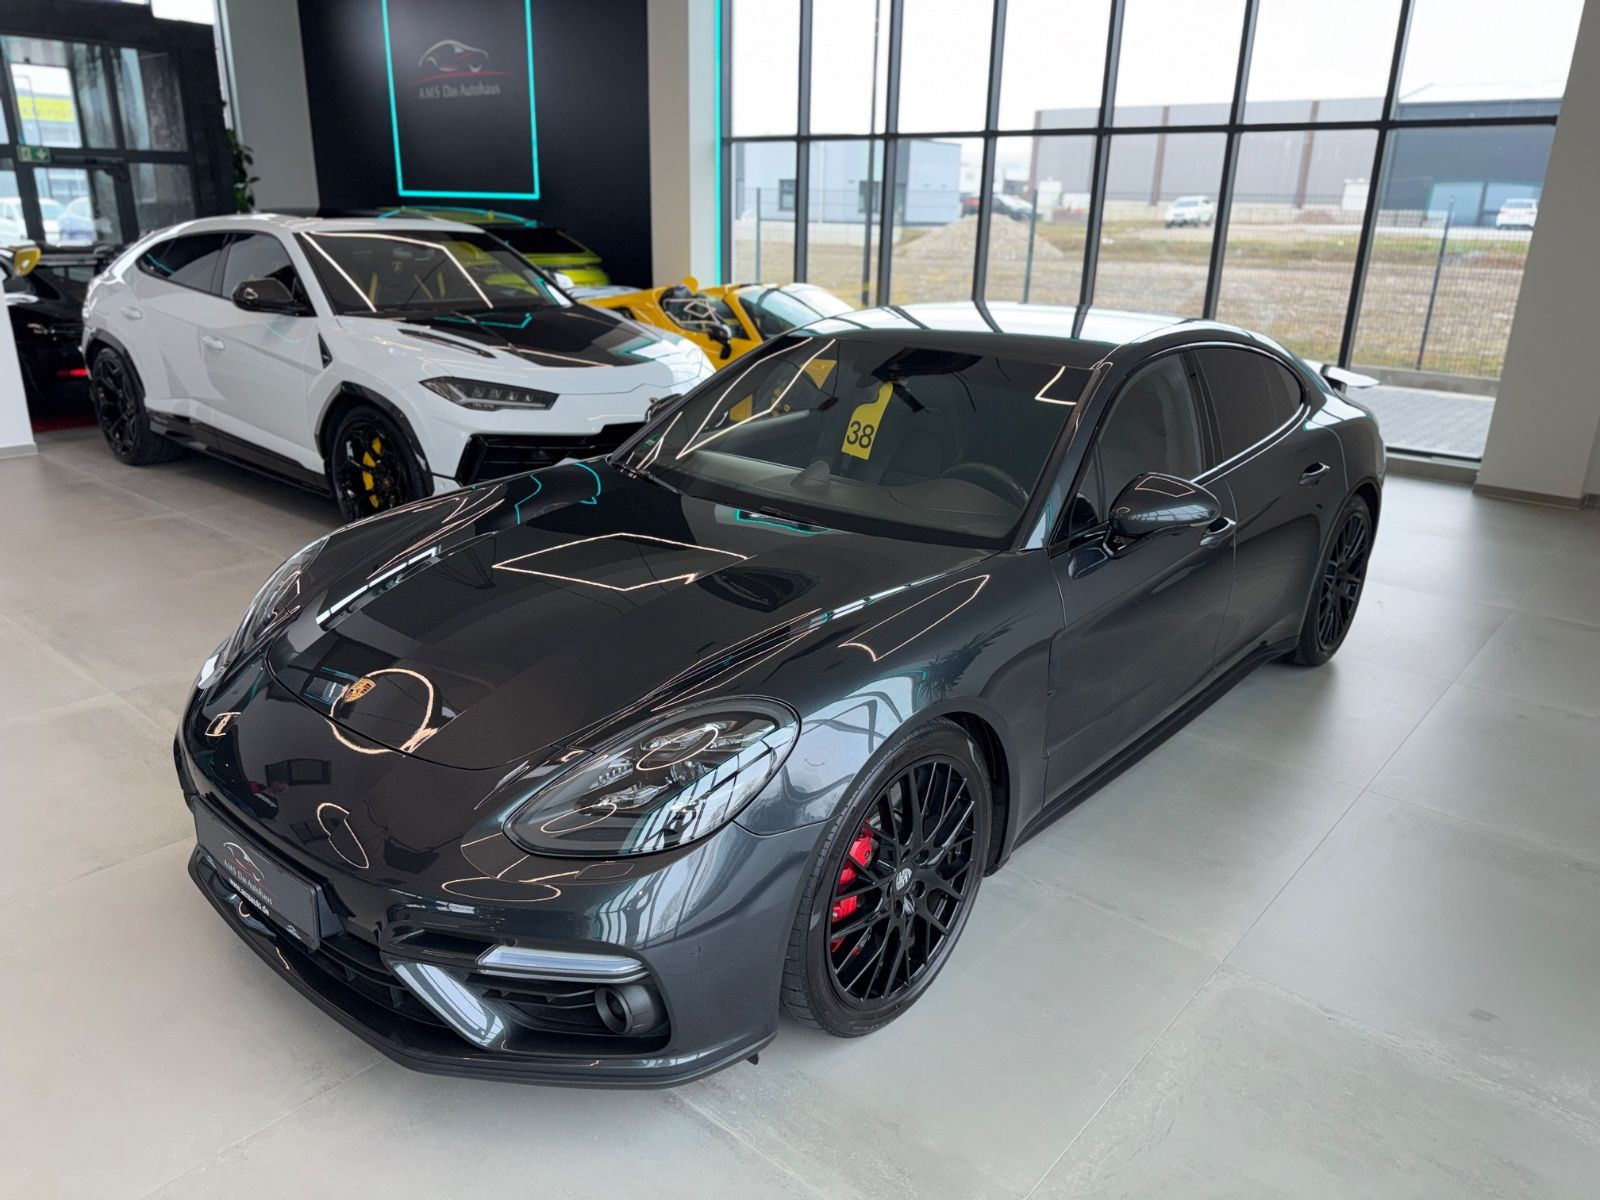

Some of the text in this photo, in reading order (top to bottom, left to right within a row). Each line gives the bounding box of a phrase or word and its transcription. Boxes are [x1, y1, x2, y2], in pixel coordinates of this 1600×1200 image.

[418, 81, 501, 100] AMS Das Autohaus
[846, 420, 875, 449] 38
[224, 858, 273, 905] AMS Das Autohaus
